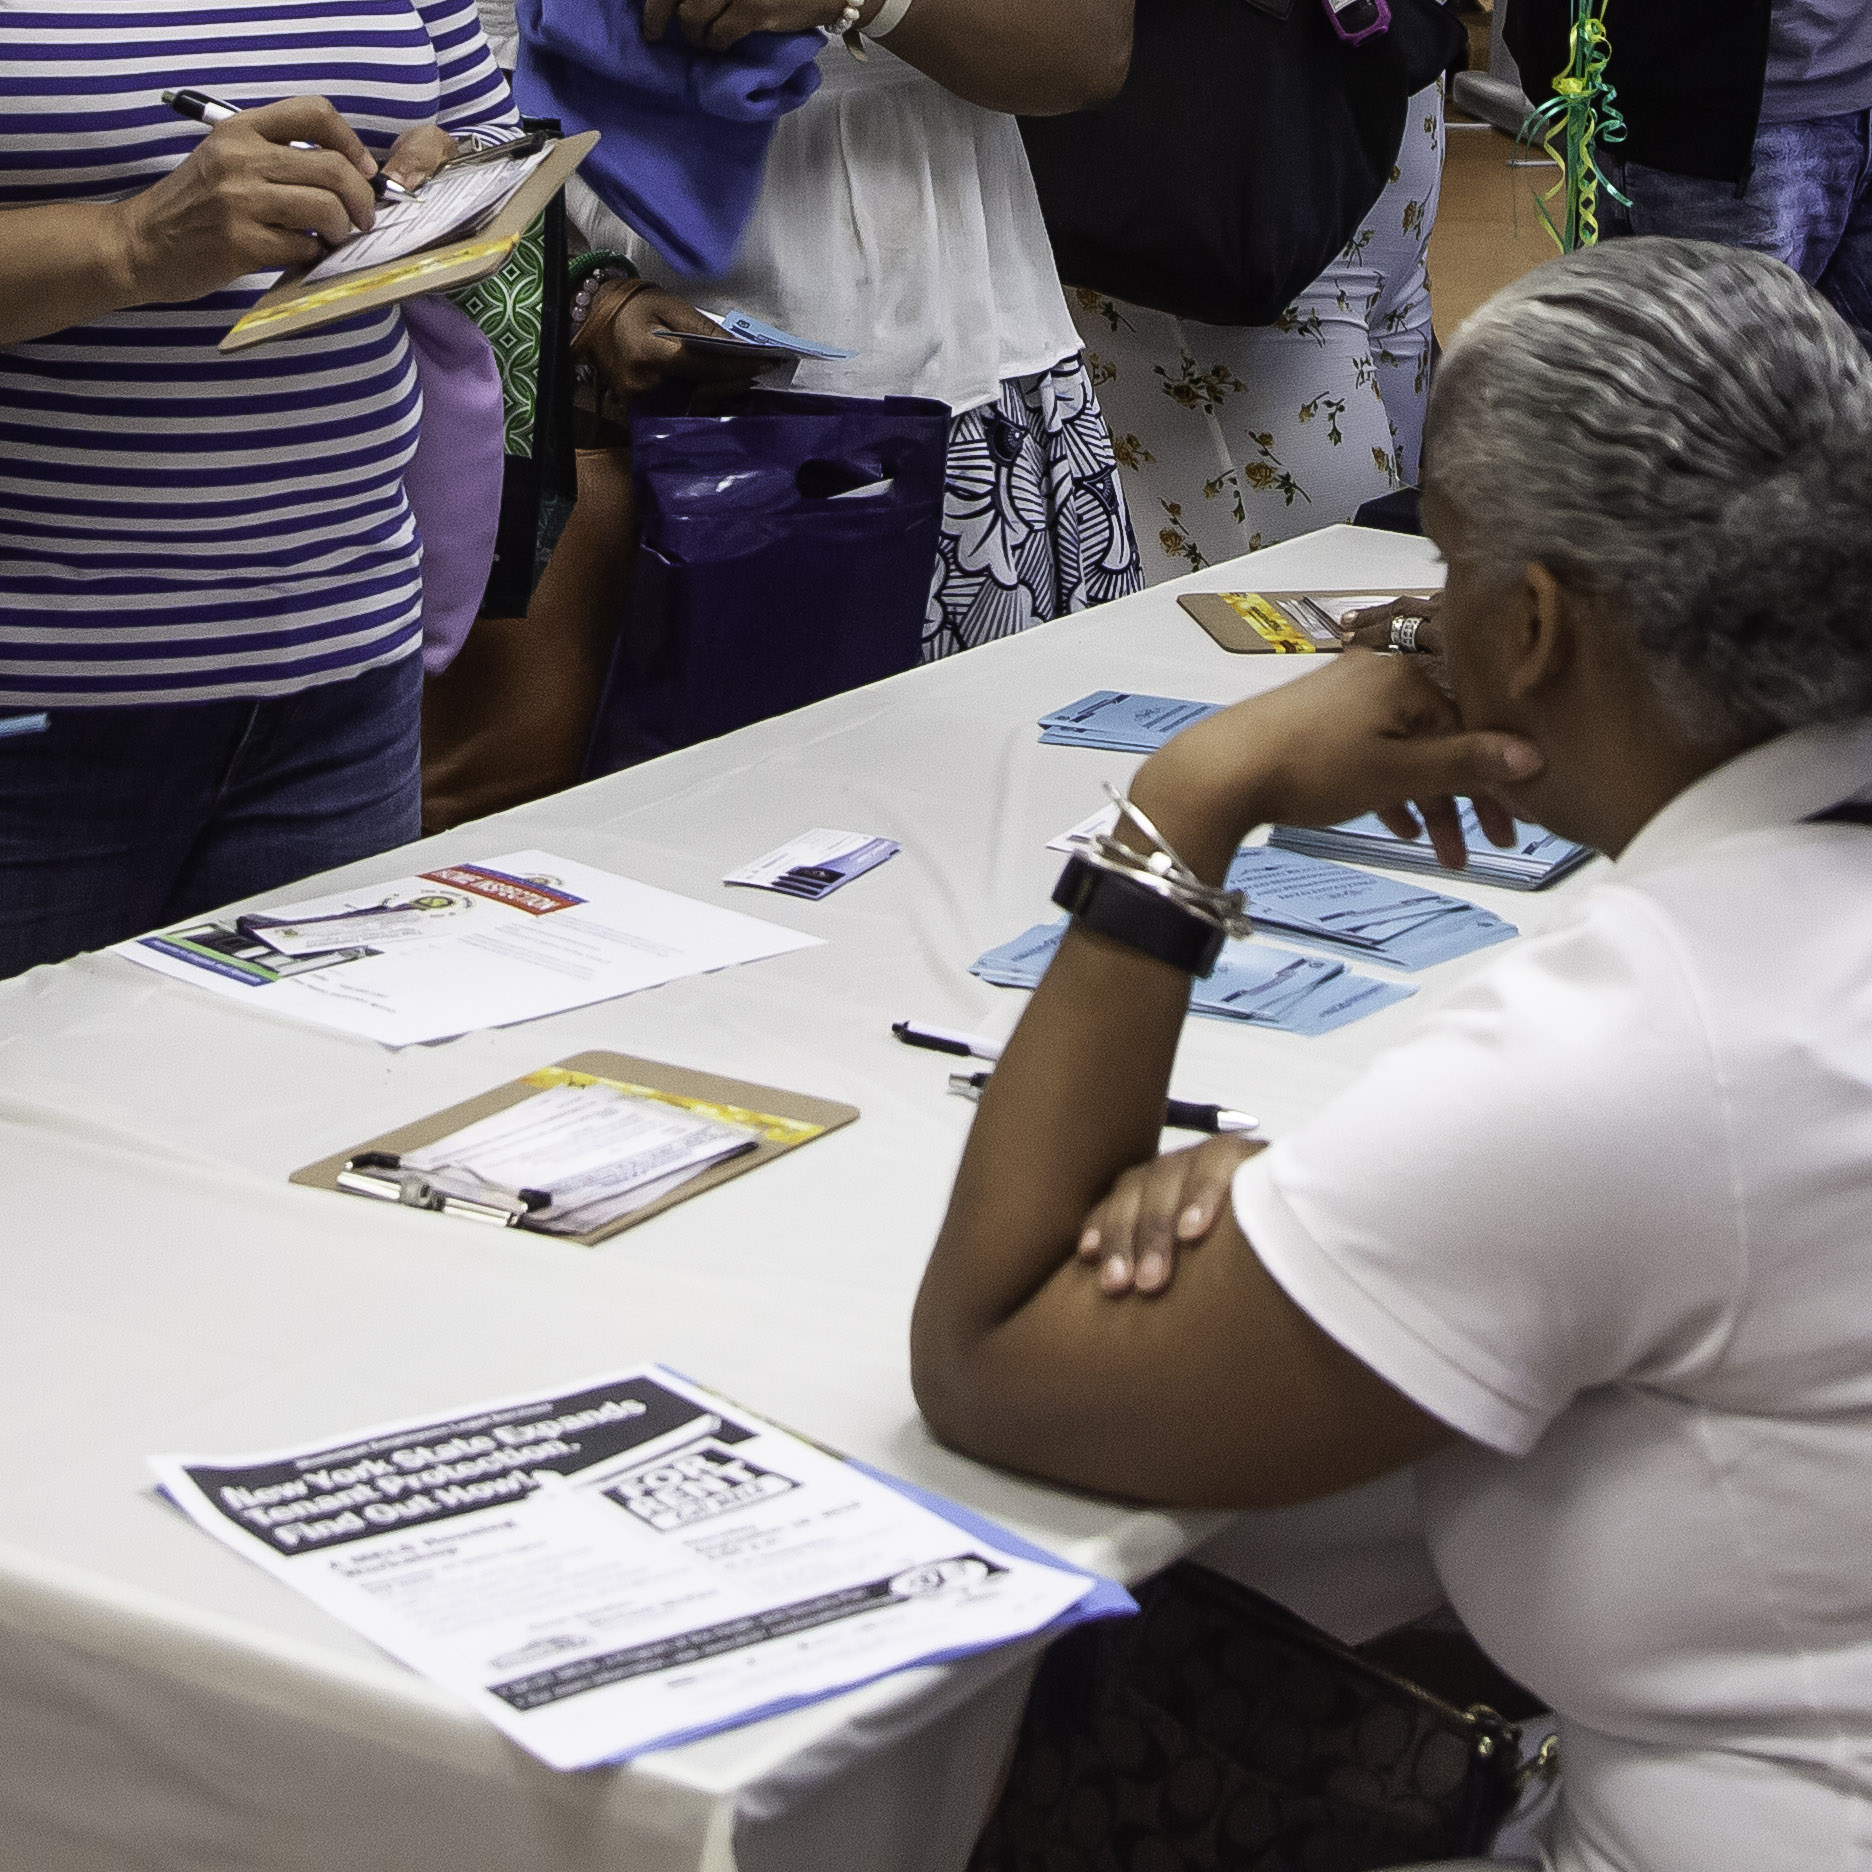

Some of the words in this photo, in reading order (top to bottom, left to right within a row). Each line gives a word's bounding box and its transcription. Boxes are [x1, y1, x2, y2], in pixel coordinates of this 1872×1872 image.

[301, 1458, 396, 1493] York
[392, 1434, 498, 1471] State
[492, 1399, 647, 1446] Expands
